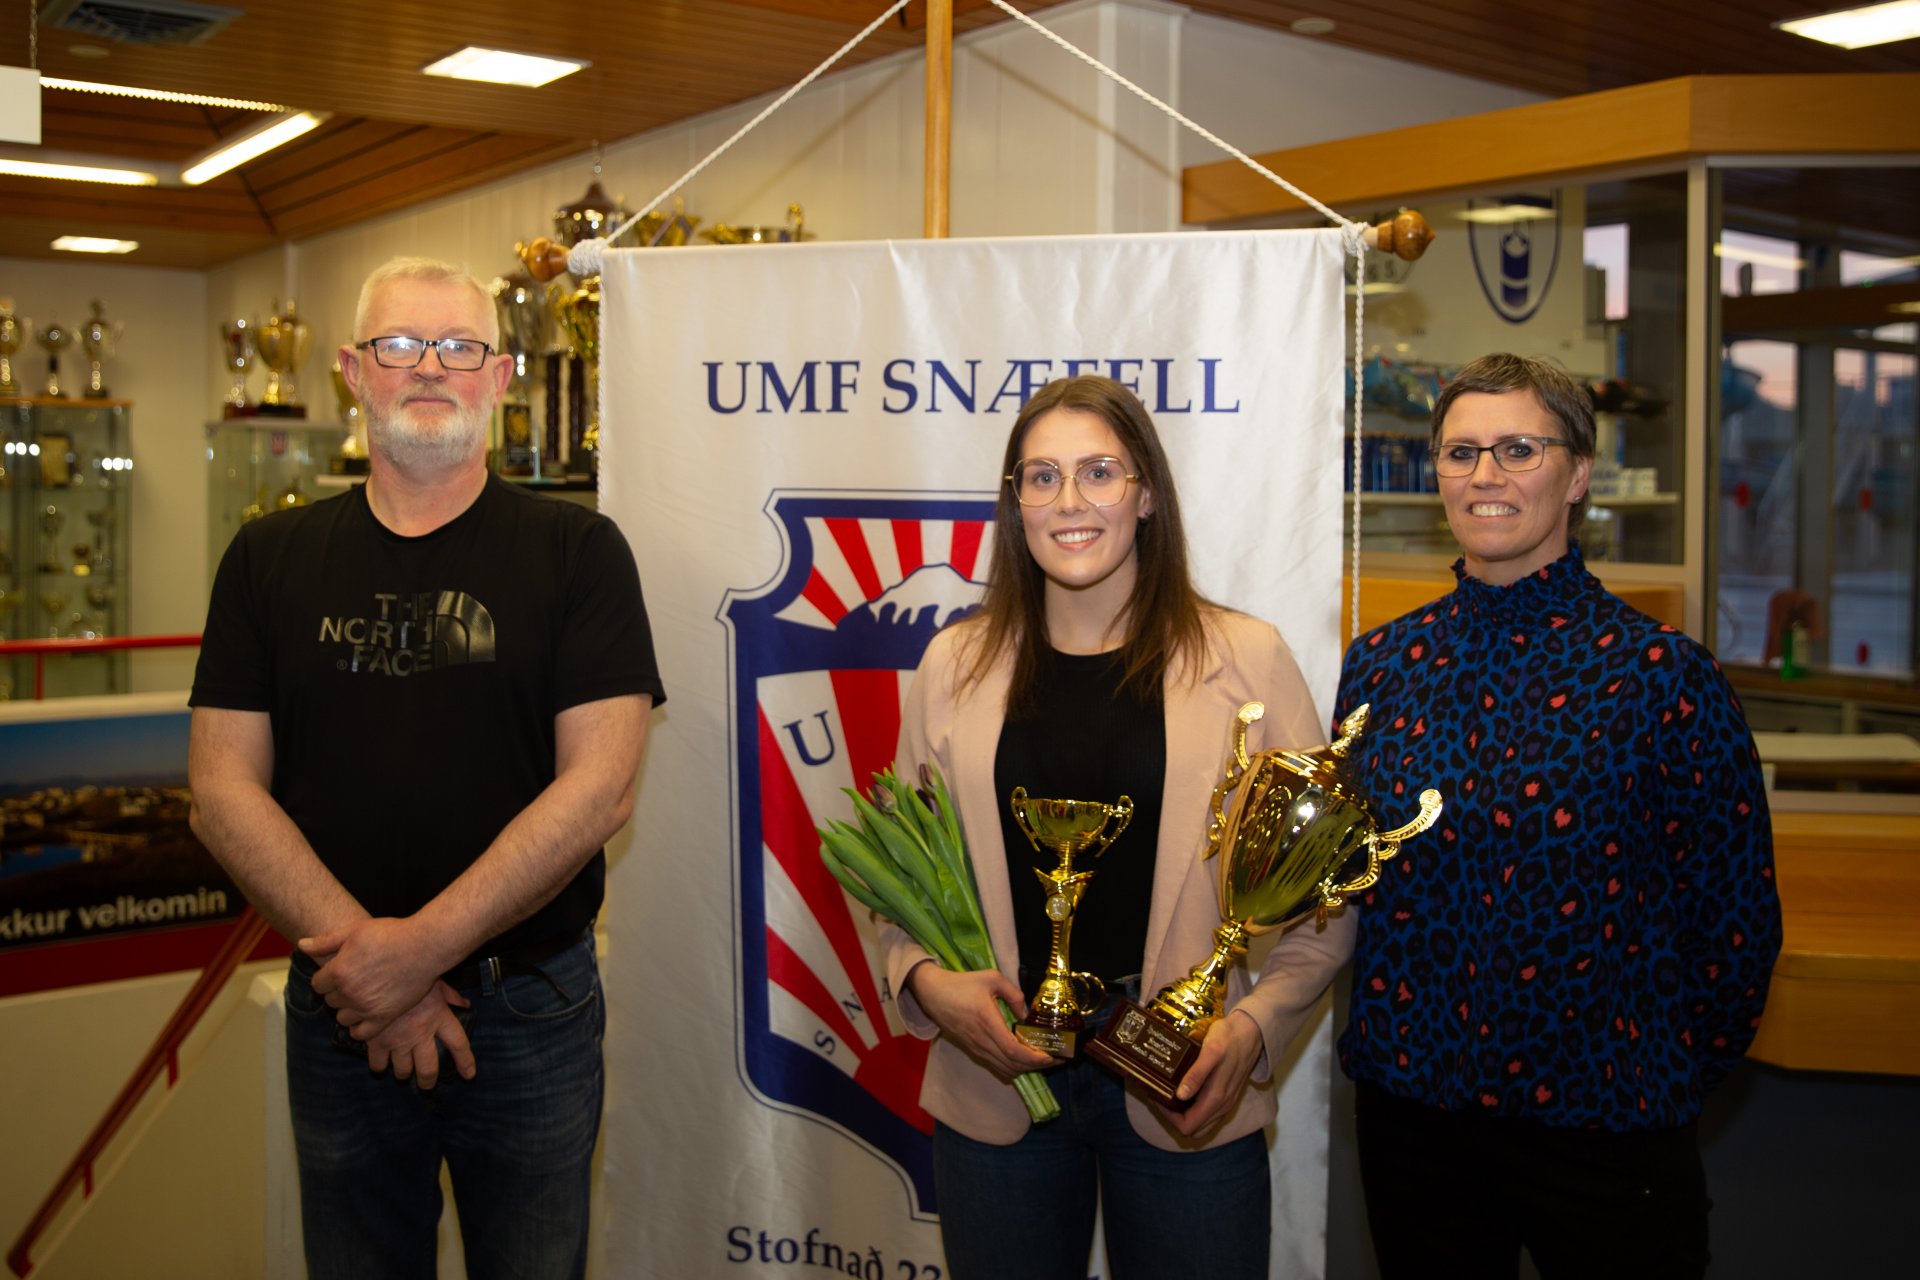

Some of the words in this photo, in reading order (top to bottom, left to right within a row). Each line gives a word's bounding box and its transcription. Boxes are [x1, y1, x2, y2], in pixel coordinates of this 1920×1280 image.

[702, 361, 861, 414] UMF
[375, 591, 433, 621] THE
[318, 616, 433, 649] NORTH
[351, 644, 433, 677] FACE
[782, 709, 836, 767] U
[78, 887, 228, 930] velkomin
[726, 1225, 885, 1280] Stofnað
